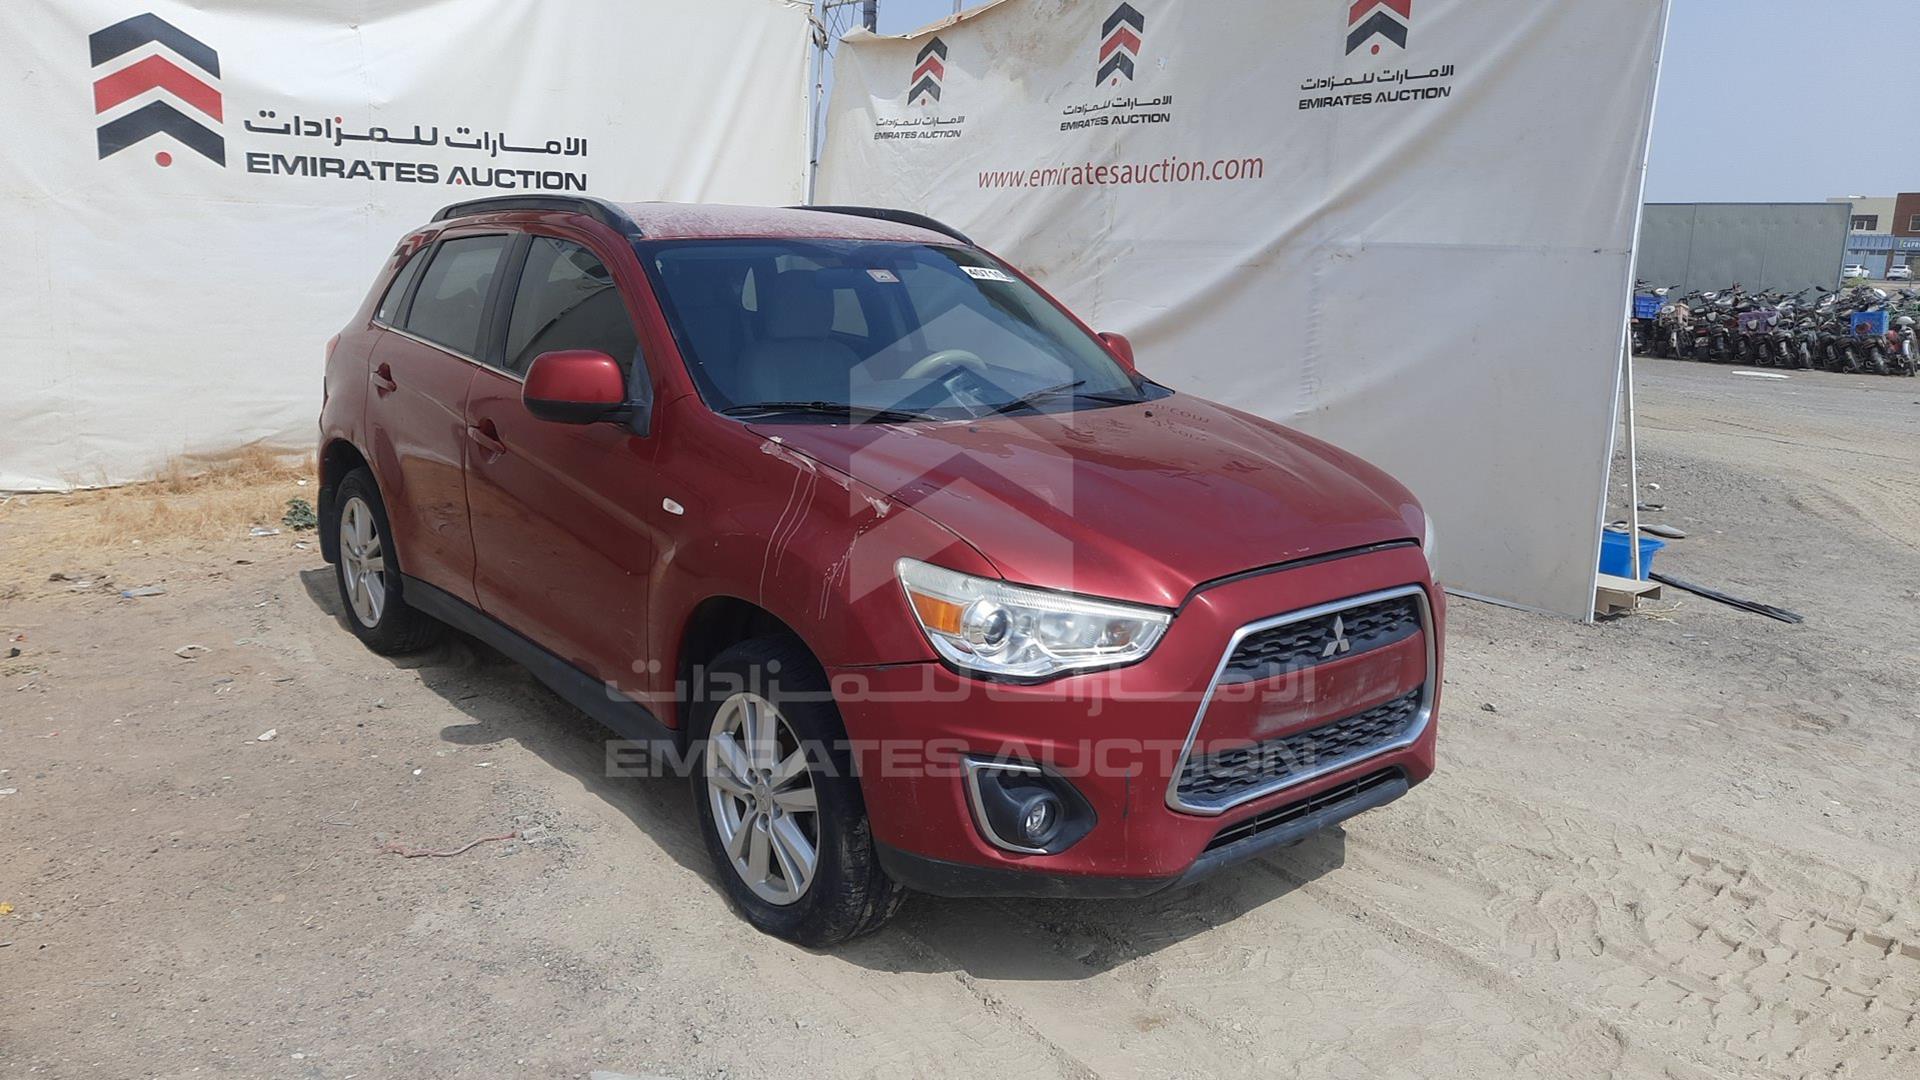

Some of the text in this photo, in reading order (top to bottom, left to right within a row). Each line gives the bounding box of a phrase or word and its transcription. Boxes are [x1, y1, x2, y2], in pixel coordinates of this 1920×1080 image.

[1298, 86, 1451, 110] EMIRATES AUCTION
[243, 110, 587, 157] الامارات للمزادات
[874, 129, 962, 140] EMIRATES AUCTION
[1060, 113, 1171, 131] EMIRATES AUCTION
[246, 152, 587, 191] EMIRATES AUCTION
[978, 156, 1263, 188] www.emiratesauction.com
